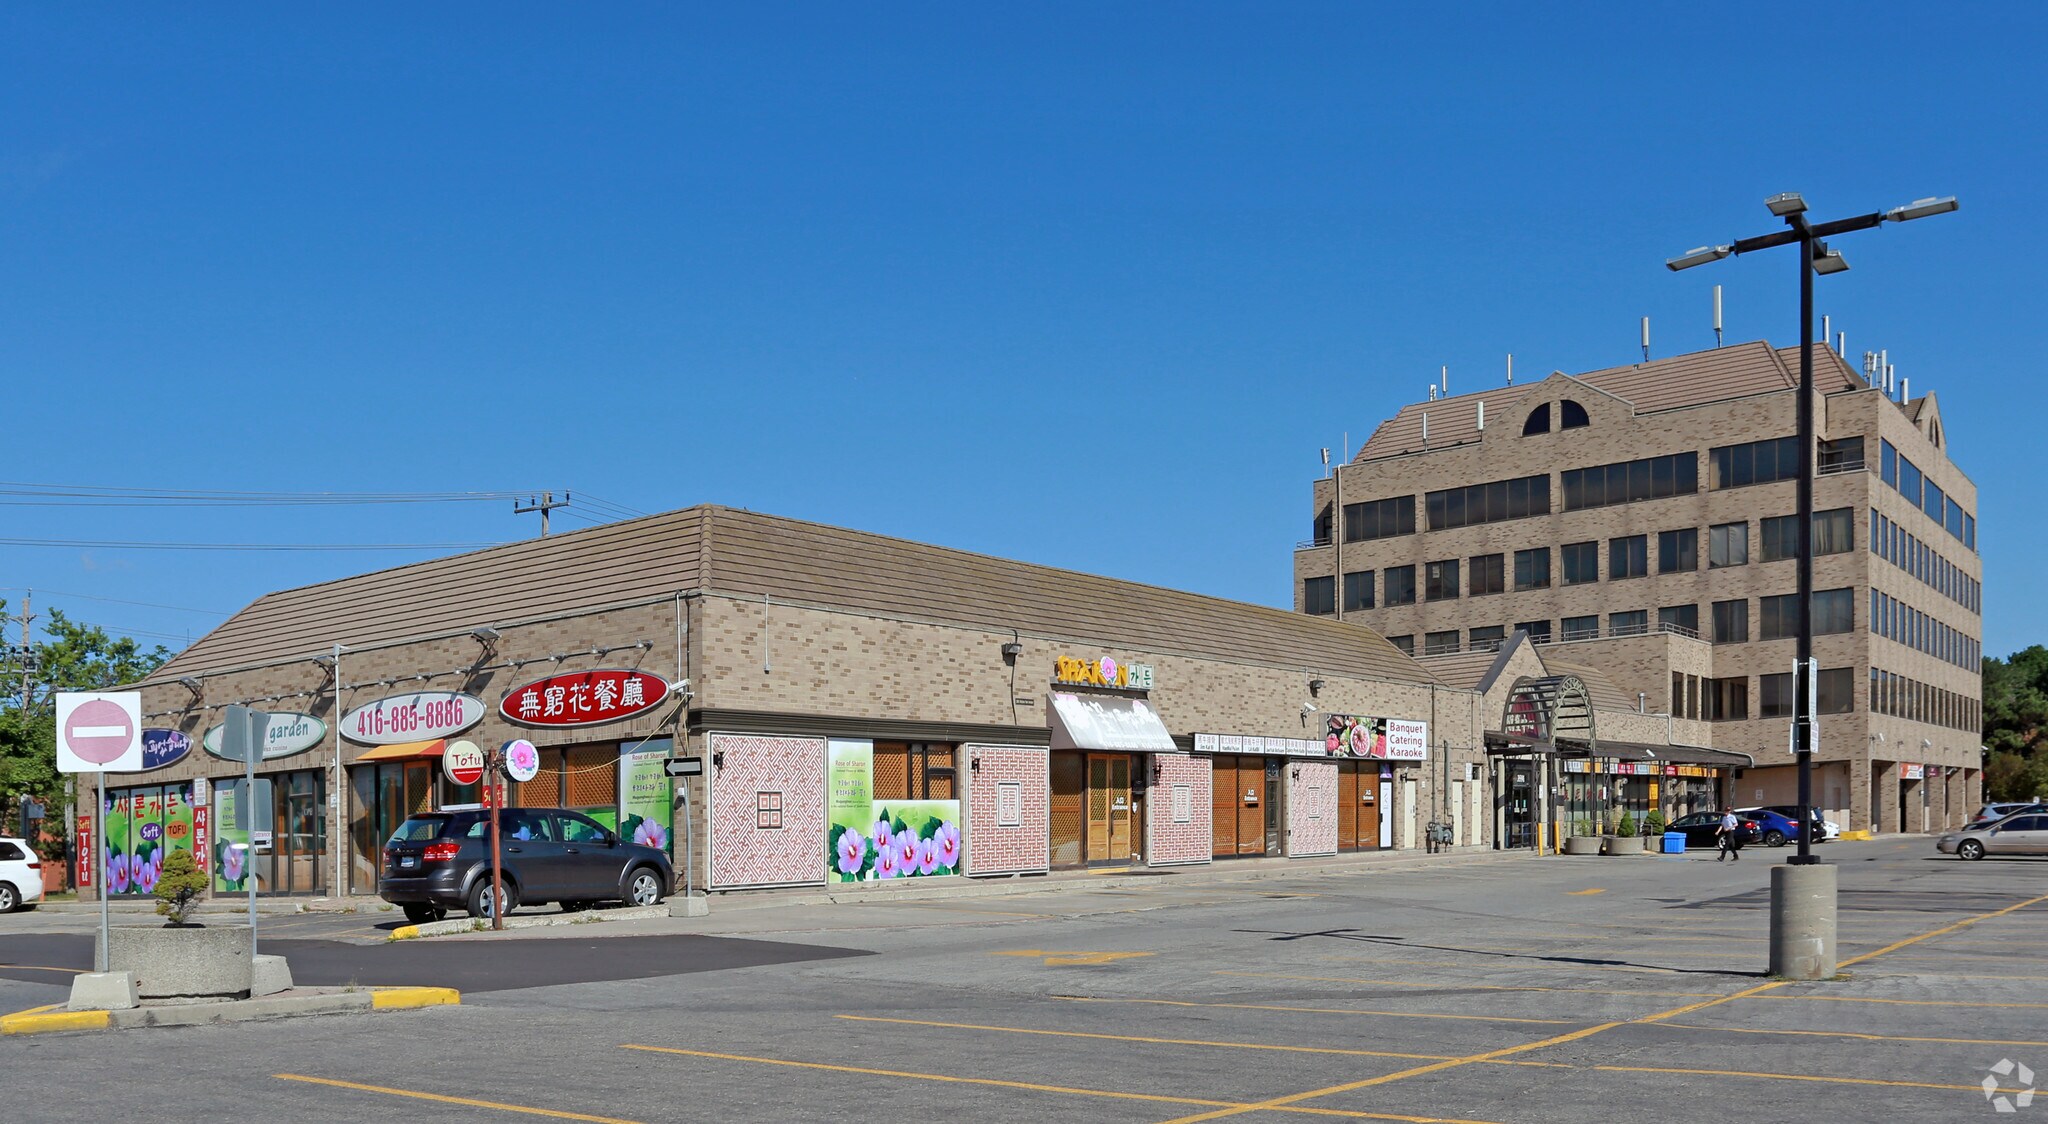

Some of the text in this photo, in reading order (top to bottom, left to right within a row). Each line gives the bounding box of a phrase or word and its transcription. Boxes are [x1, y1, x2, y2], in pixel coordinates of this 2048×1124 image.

[1130, 665, 1153, 685] 가든
[518, 676, 646, 720] 無窮花餐廳
[357, 698, 463, 737] 416-885-8886
[269, 721, 309, 743] garden
[1389, 721, 1423, 735] Banquet
[1389, 734, 1423, 748] Catering
[452, 753, 481, 766] Tofu
[1390, 746, 1423, 758] Karaoke
[142, 825, 187, 838] Soft TOFU
[80, 832, 89, 882] Tofu
